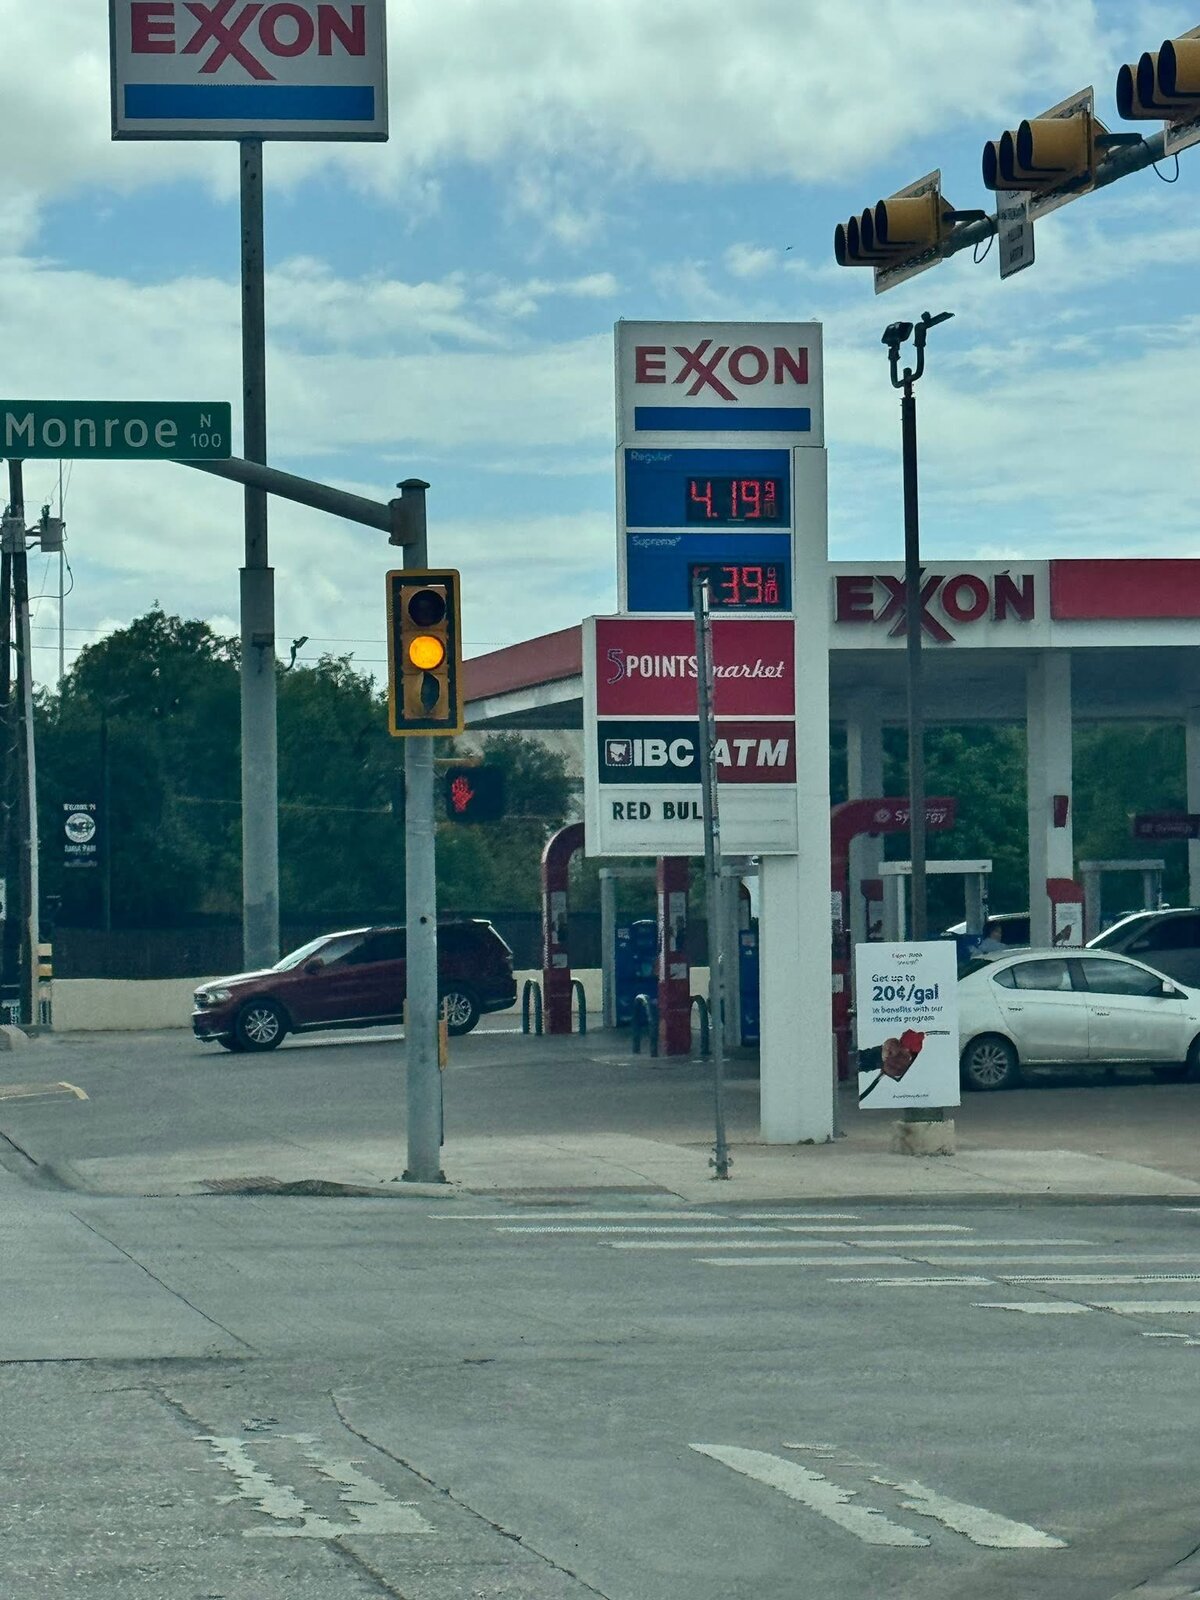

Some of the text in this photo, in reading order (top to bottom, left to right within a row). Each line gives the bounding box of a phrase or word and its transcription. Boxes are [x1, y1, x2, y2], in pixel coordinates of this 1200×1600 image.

[130, 0, 366, 81] EXXON
[634, 339, 809, 401] EXXON
[5, 412, 212, 448] Monroe N
[190, 433, 222, 448] 100
[834, 567, 1035, 642] EXXON
[633, 738, 694, 767] IBC
[710, 739, 789, 767] ATM
[612, 801, 651, 820] RED
[871, 974, 916, 984] Get up to
[872, 983, 939, 1005] 20¢/gal
